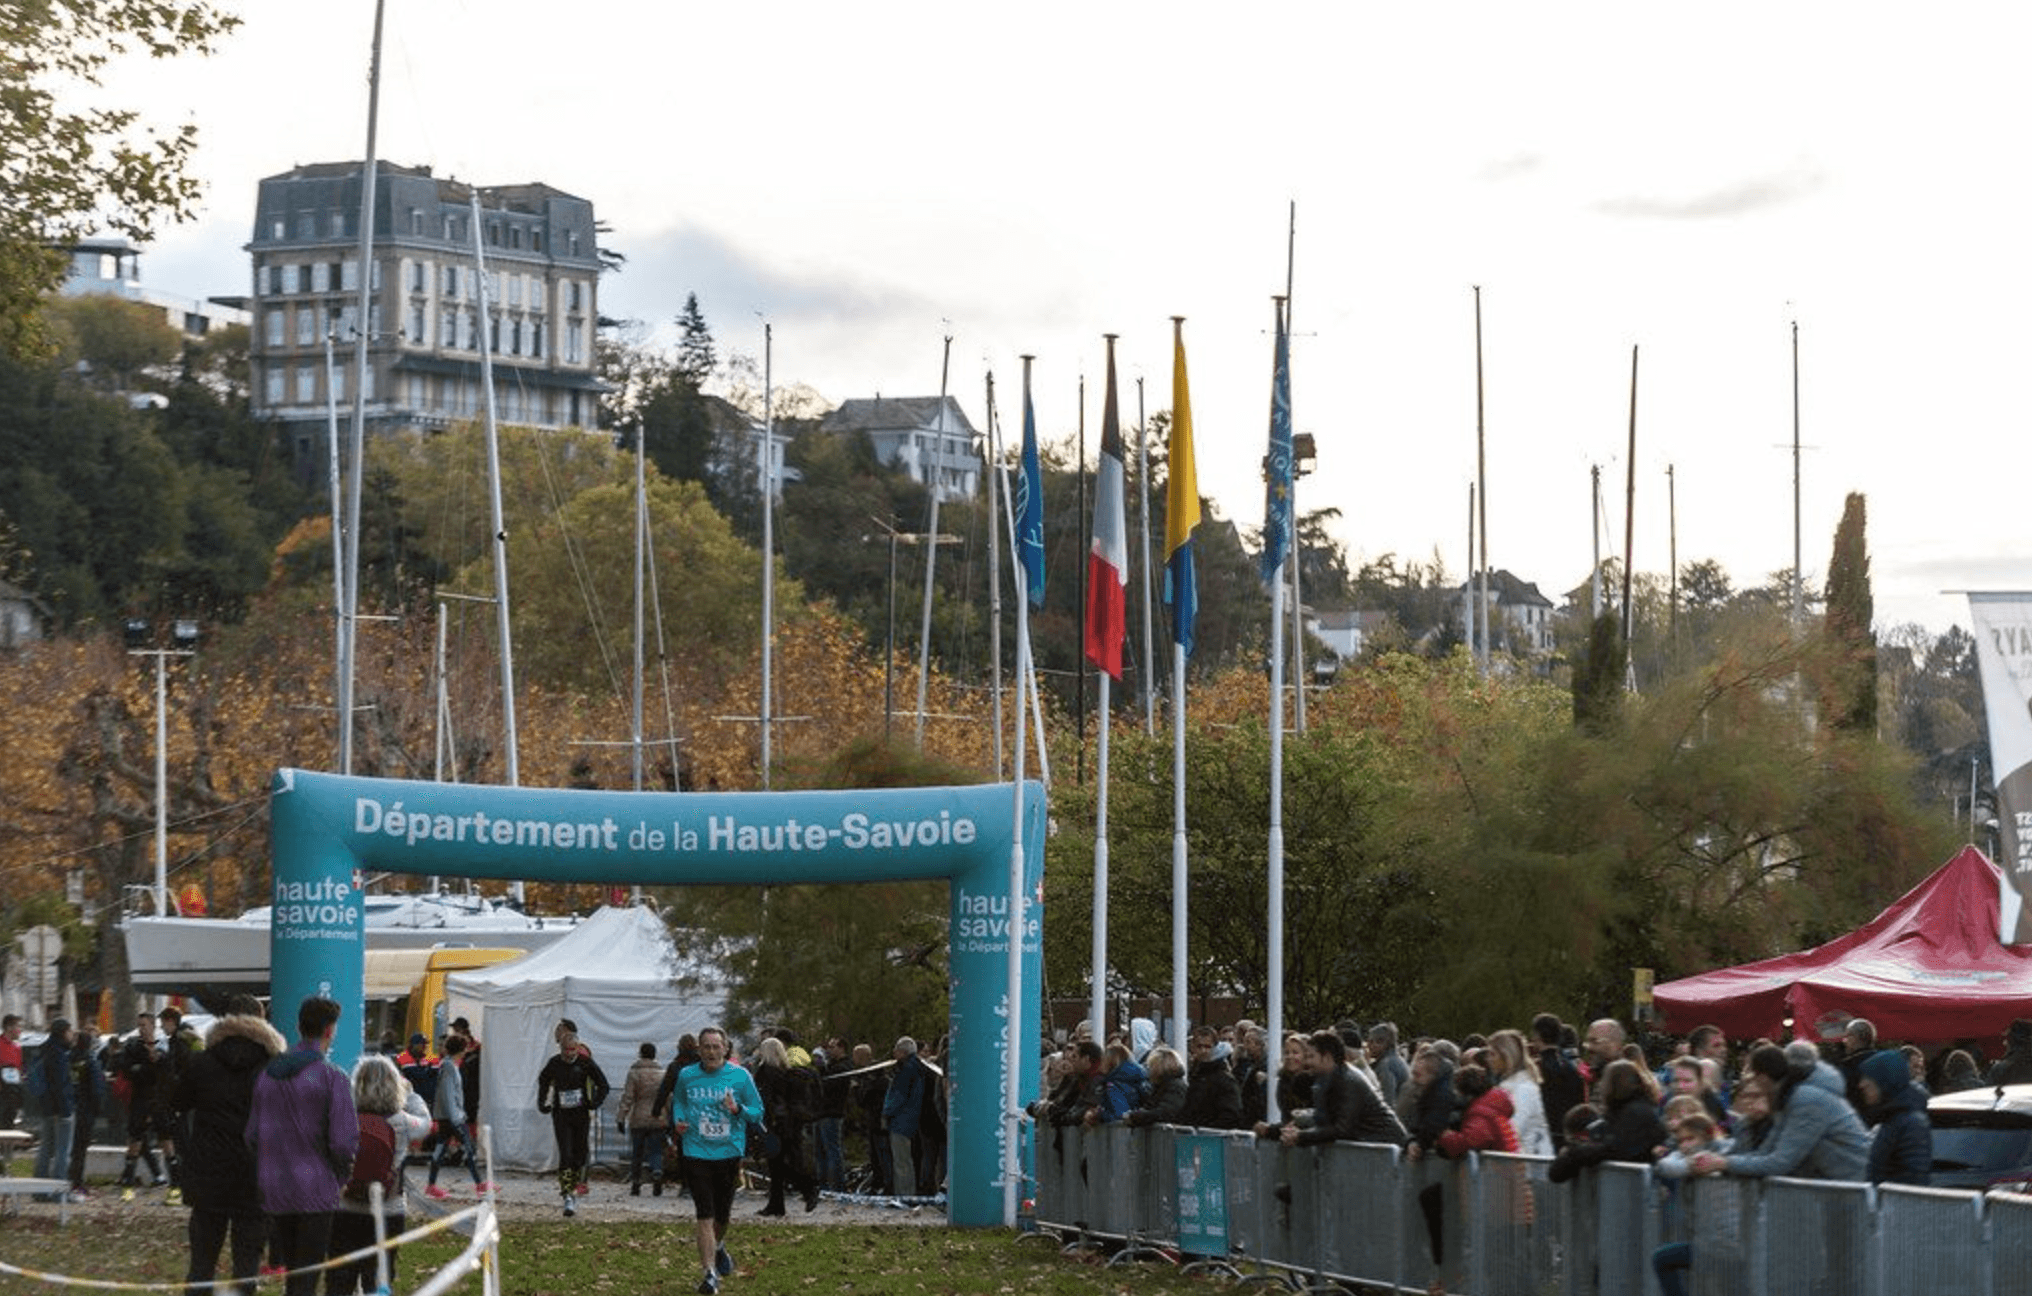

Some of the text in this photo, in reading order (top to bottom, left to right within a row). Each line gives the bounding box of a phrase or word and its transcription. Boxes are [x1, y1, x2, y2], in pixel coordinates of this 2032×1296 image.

[354, 797, 976, 851] Département de la Haute-Savoie
[276, 876, 349, 901] haute
[959, 888, 1032, 915] haue
[276, 904, 358, 925] savoie
[286, 928, 358, 941] Département
